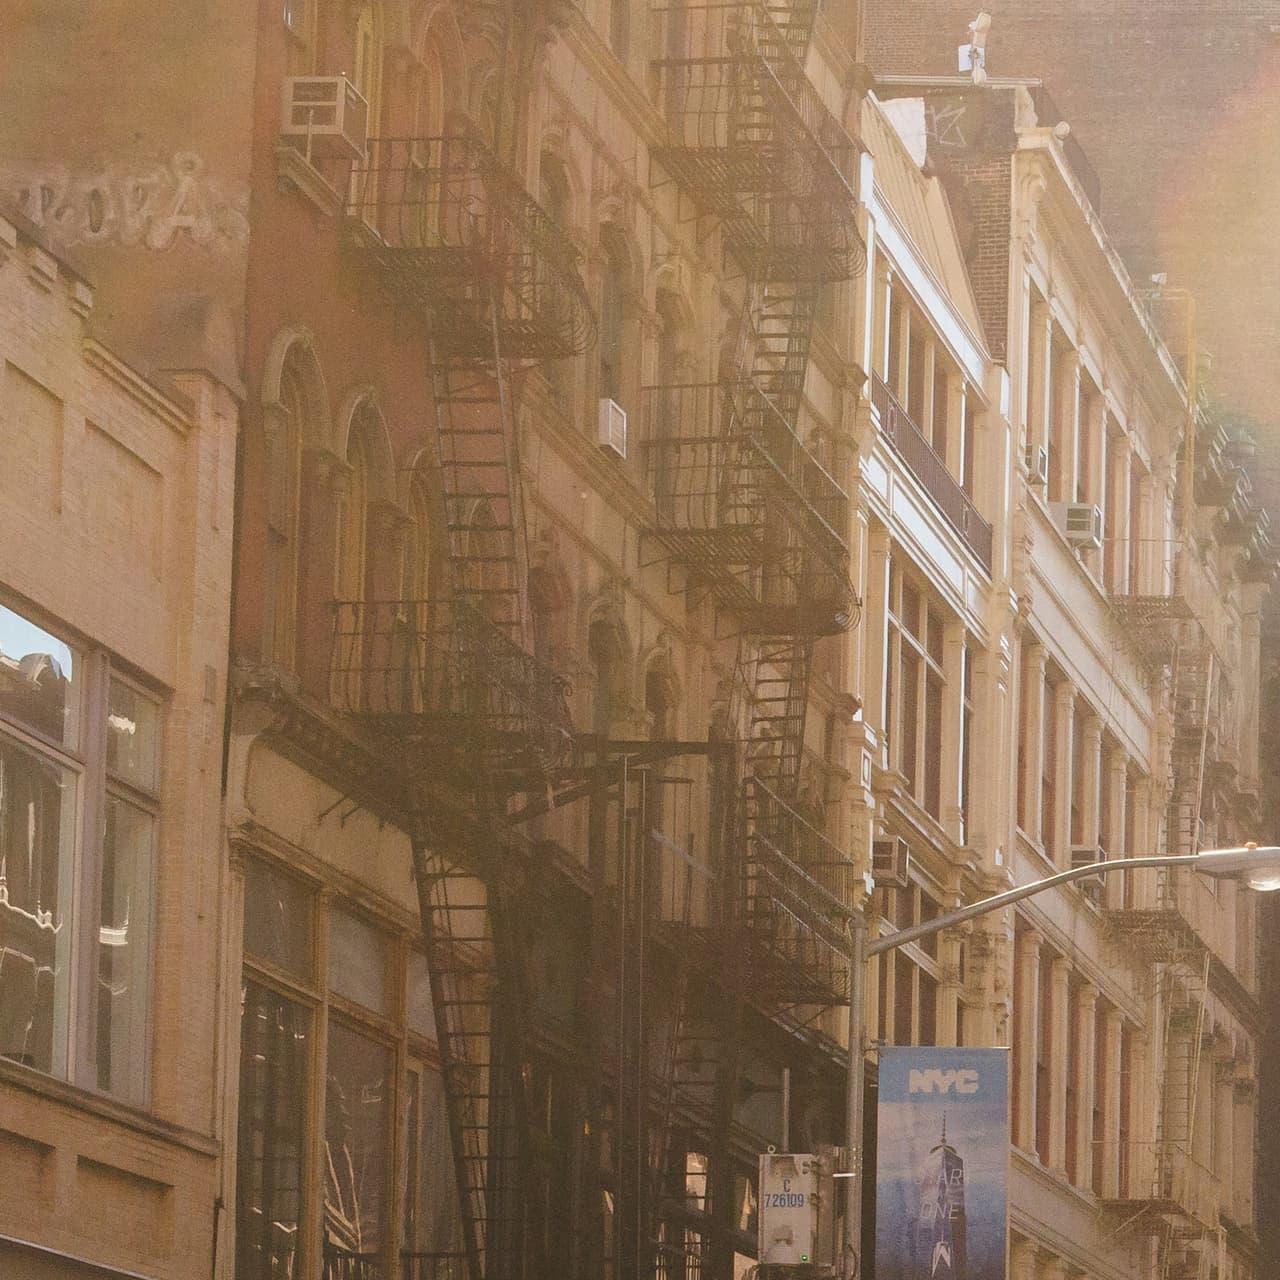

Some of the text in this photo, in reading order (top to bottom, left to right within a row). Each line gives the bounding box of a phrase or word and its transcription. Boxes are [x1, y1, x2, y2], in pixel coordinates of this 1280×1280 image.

[909, 1069, 979, 1094] NYC
[783, 1179, 791, 1192] C
[765, 1193, 804, 1208] 726109
